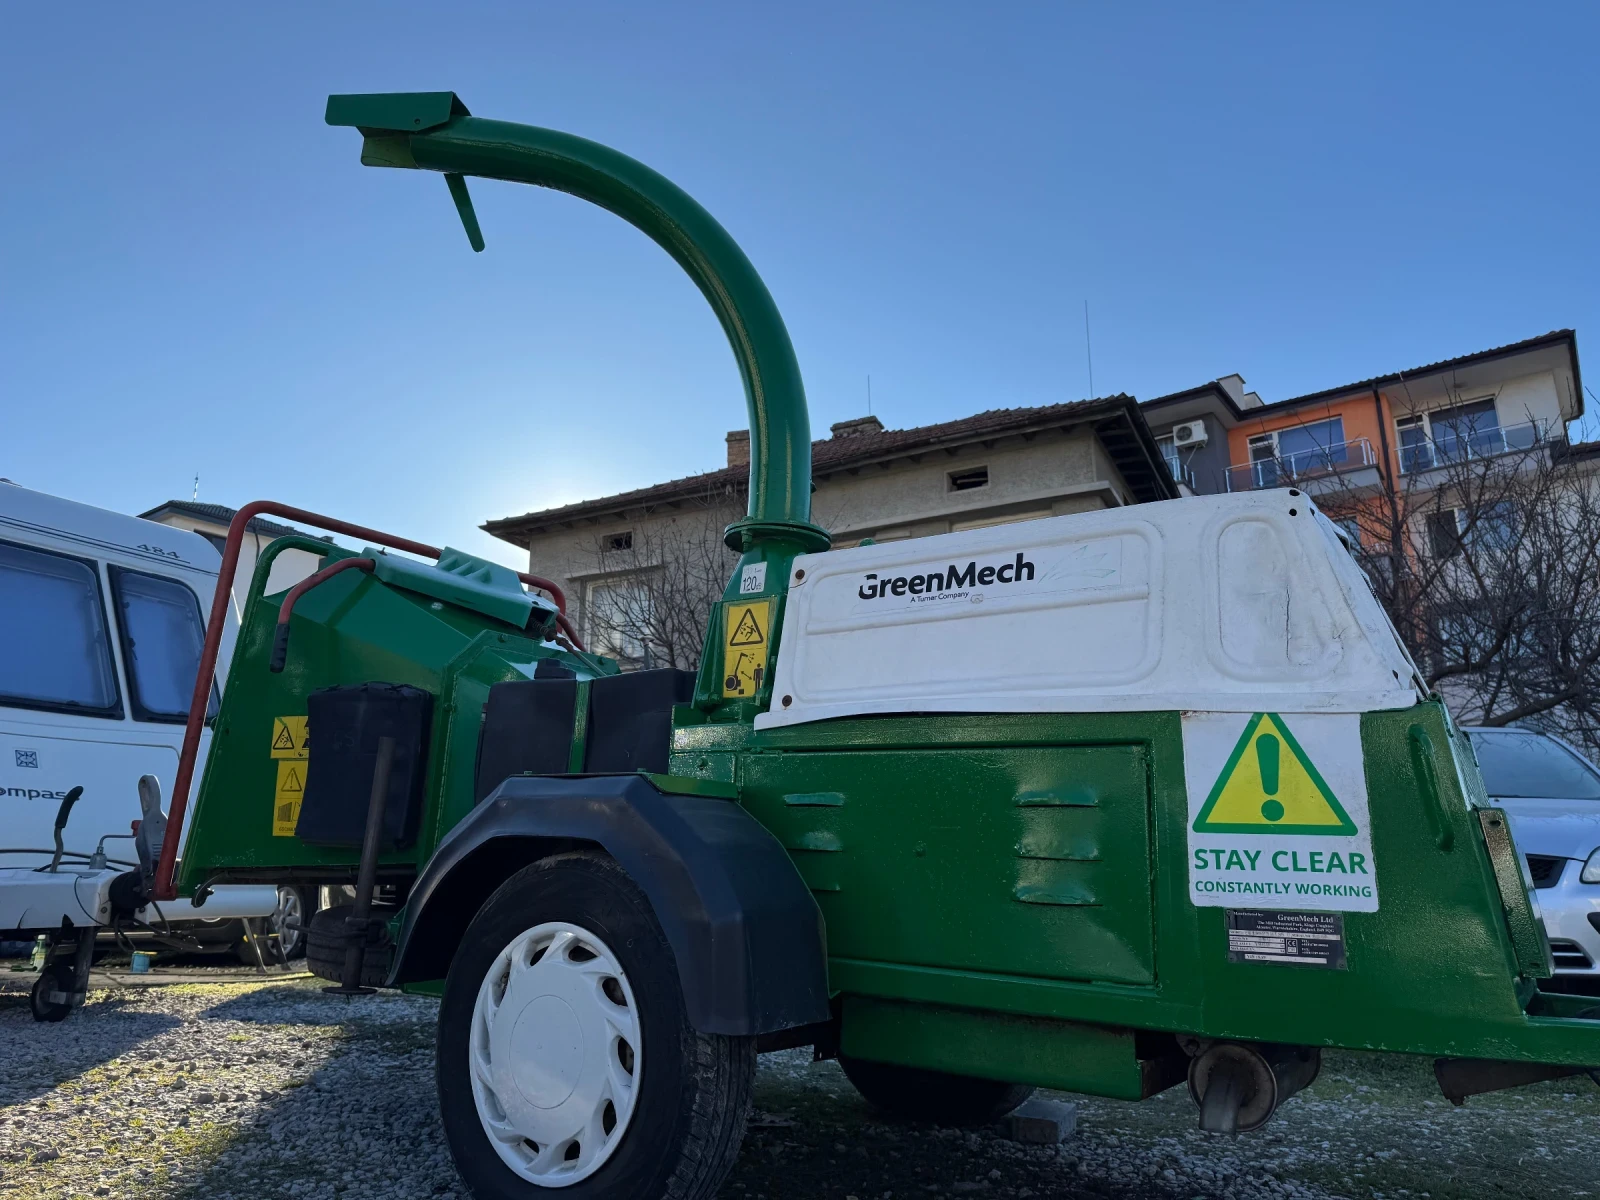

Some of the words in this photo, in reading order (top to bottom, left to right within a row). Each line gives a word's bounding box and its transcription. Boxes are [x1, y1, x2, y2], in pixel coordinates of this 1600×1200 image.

[137, 544, 180, 559] 484
[743, 575, 757, 592] 120
[858, 552, 1035, 600] GreenMech
[938, 591, 969, 601] Company
[1194, 848, 1262, 871] STAY
[1271, 850, 1369, 875] CLEAR
[1195, 880, 1291, 894] CONSTANTLY
[1294, 883, 1372, 898] WORKING
[1277, 913, 1319, 923] GreenMech
